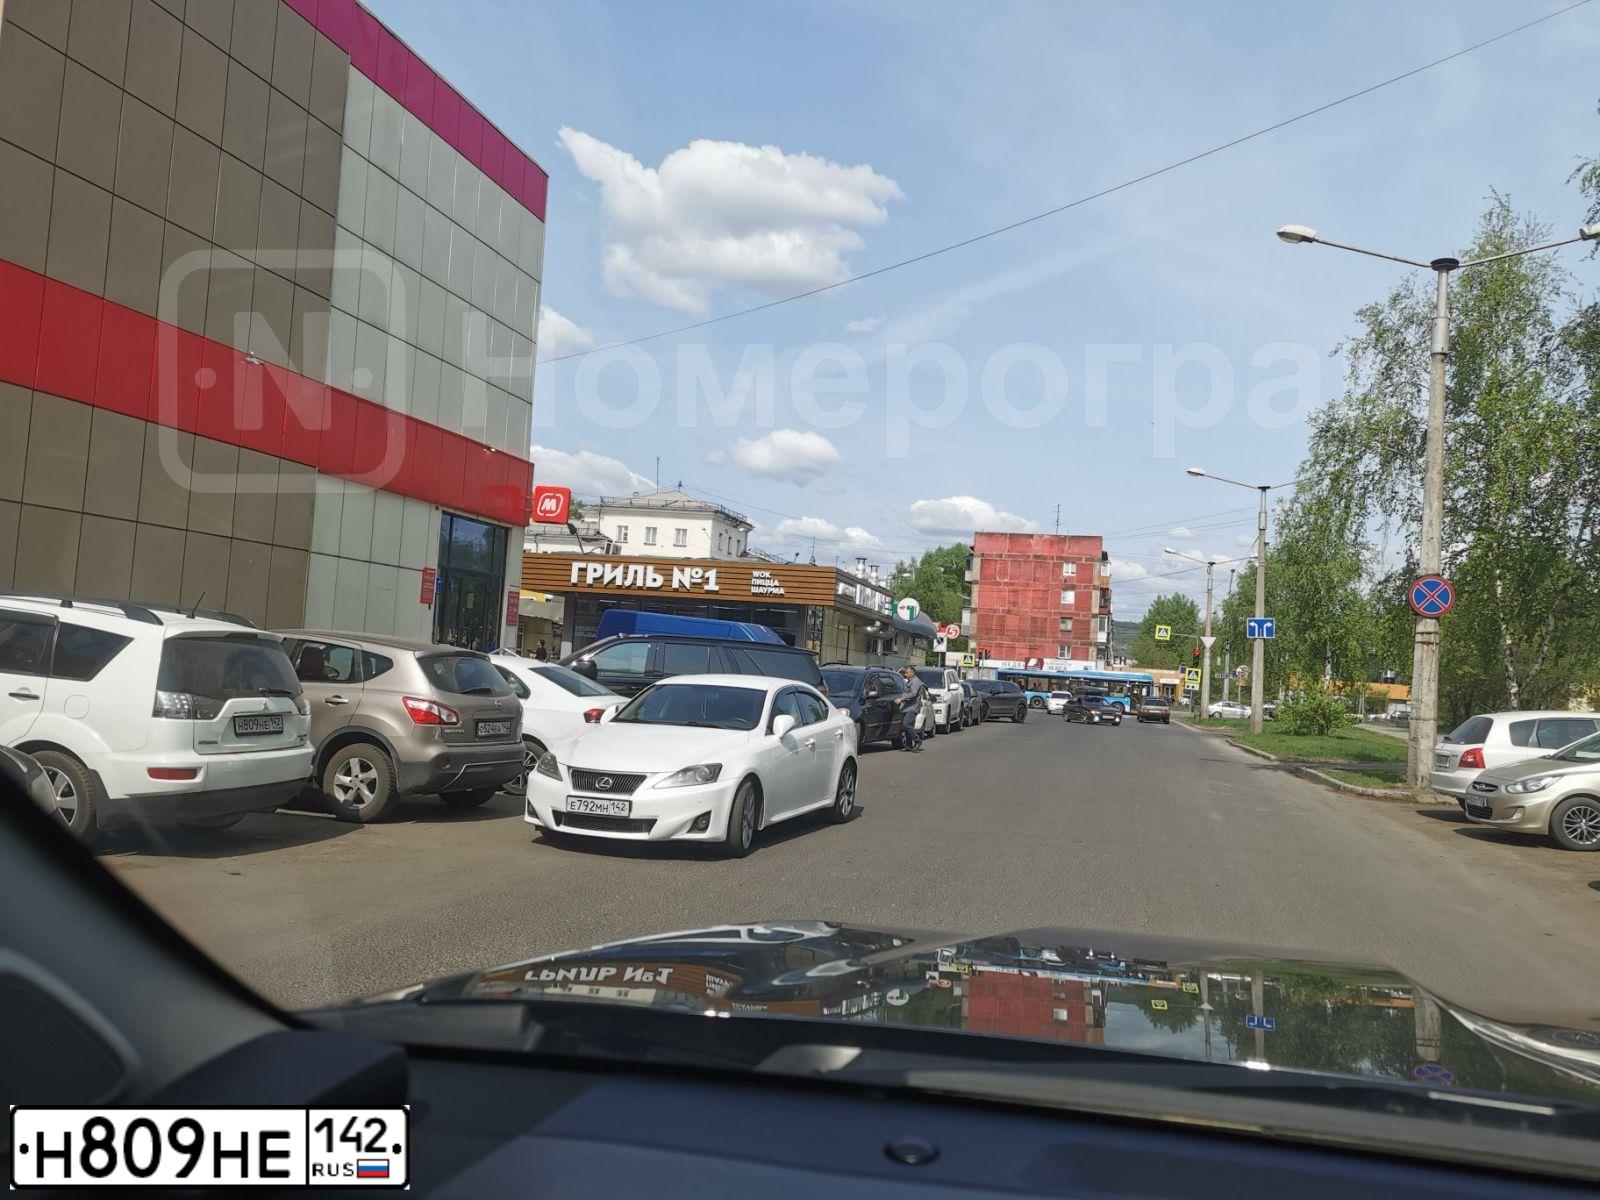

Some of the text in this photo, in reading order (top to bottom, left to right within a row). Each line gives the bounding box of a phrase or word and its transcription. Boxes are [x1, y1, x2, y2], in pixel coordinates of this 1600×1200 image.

[570, 561, 720, 592] ГРИЛЬ №1
[752, 570, 772, 578] WOK
[751, 578, 780, 587] ПИЦЦА
[750, 586, 785, 595] ШАУРМА
[237, 718, 269, 731] Н809НЕ
[570, 800, 626, 812] Е792МН 142
